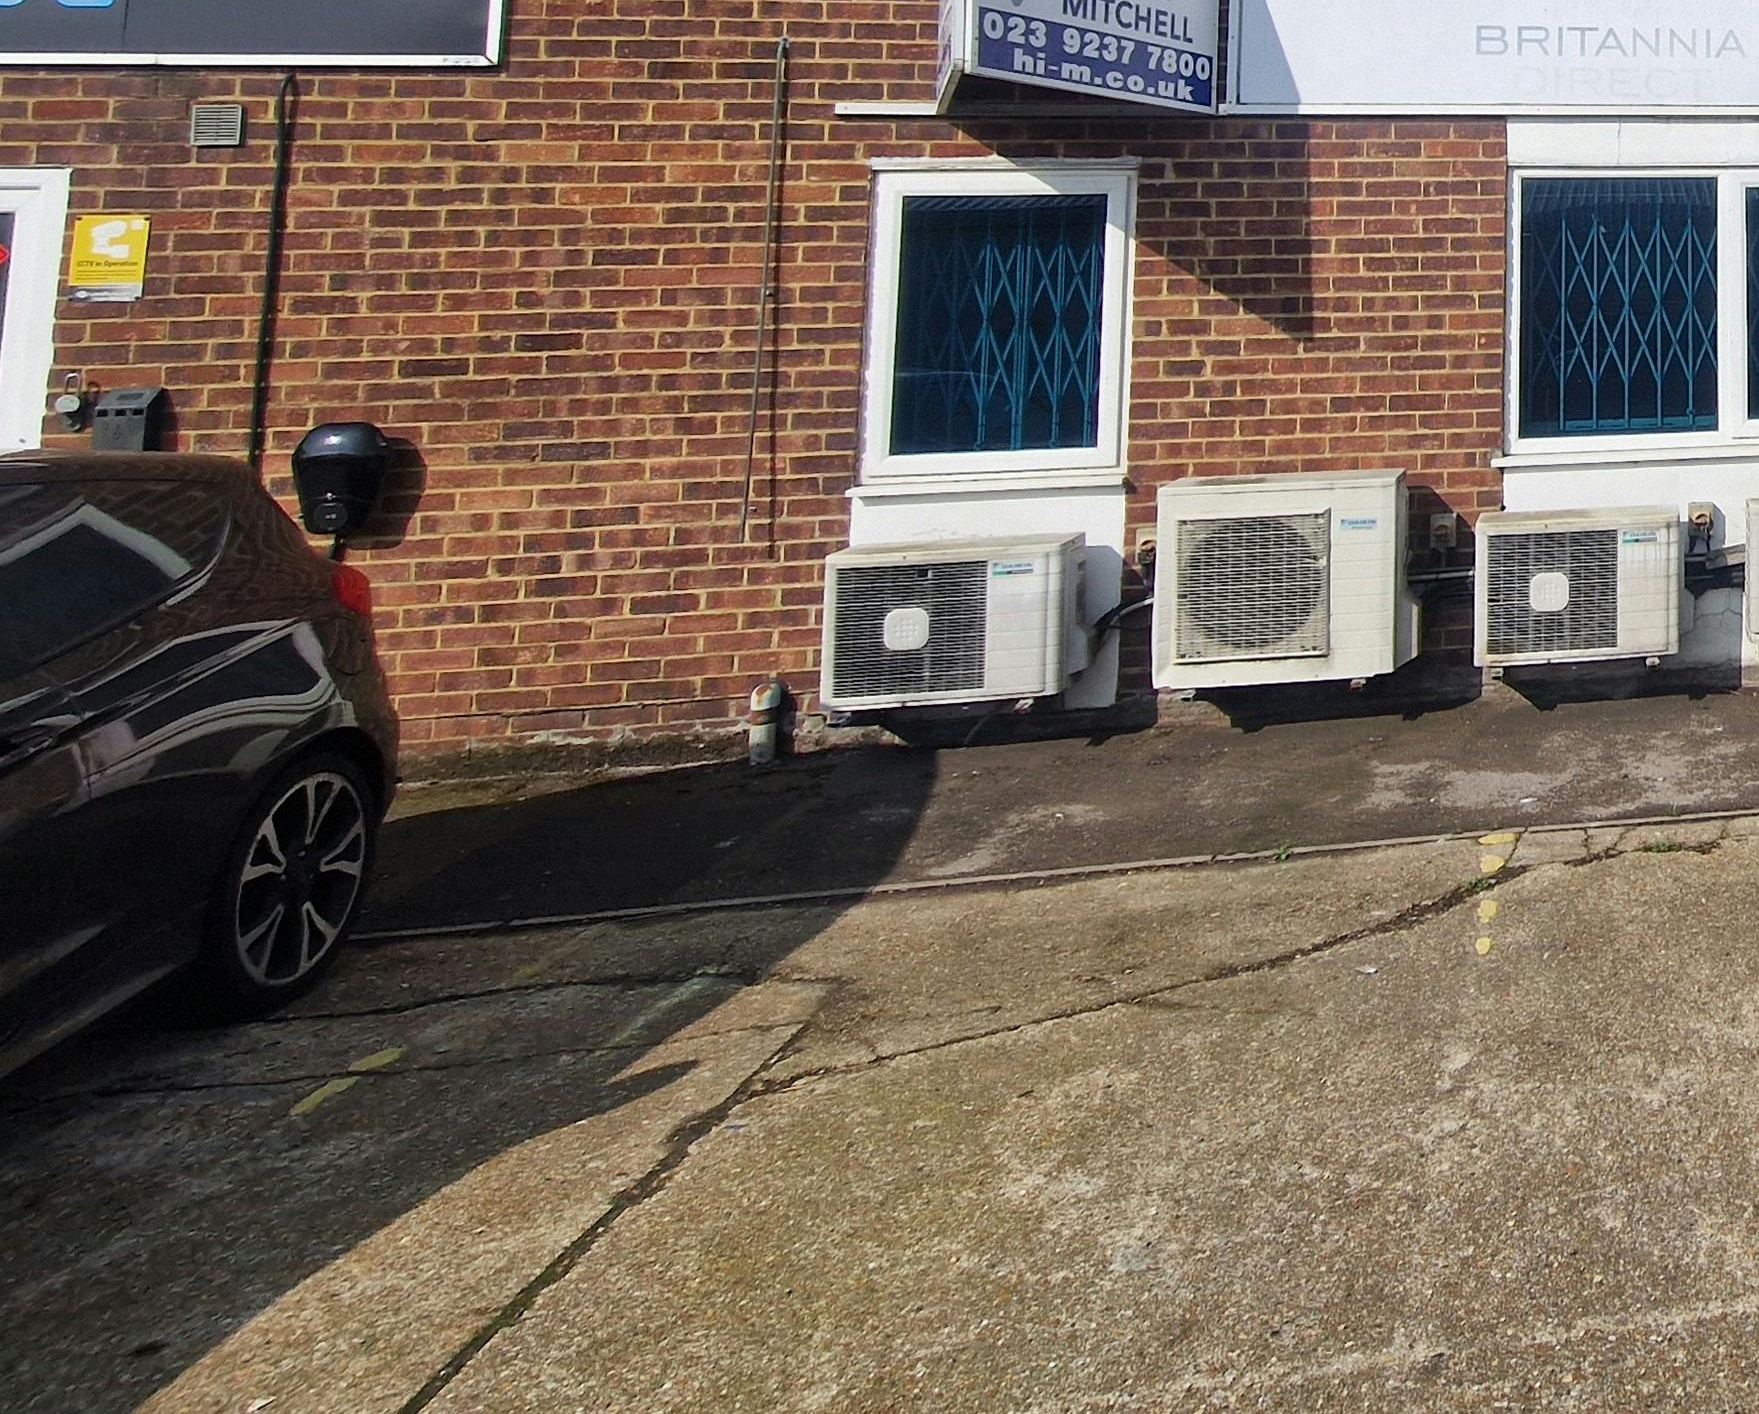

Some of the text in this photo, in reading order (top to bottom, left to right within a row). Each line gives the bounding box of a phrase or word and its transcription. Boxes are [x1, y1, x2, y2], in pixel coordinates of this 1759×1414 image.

[983, 11, 1210, 81] 023 9237 7800
[1474, 24, 1748, 60] BRITANNIA
[1013, 48, 1194, 101] hi-m.co.uk
